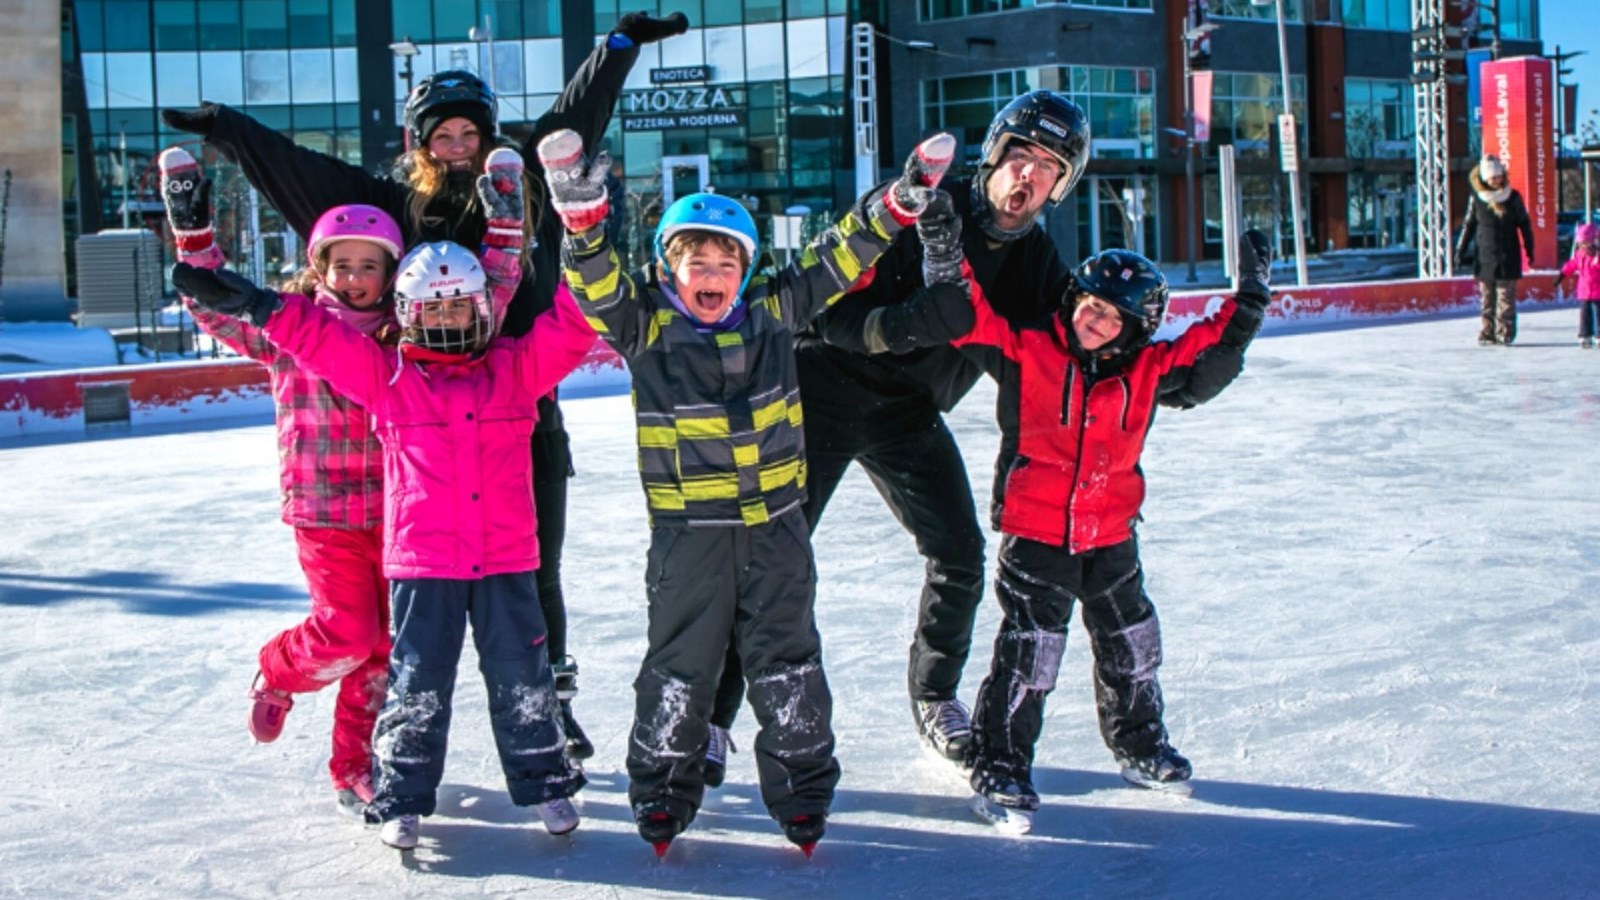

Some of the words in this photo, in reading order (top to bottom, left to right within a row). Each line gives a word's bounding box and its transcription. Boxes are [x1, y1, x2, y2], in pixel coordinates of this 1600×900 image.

[653, 68, 704, 80] ENOTECA
[630, 88, 728, 111] MOZZA
[625, 118, 676, 128] PIZZERIA
[680, 113, 738, 126] MODERNA
[1533, 72, 1546, 228] #CentropolisLaval
